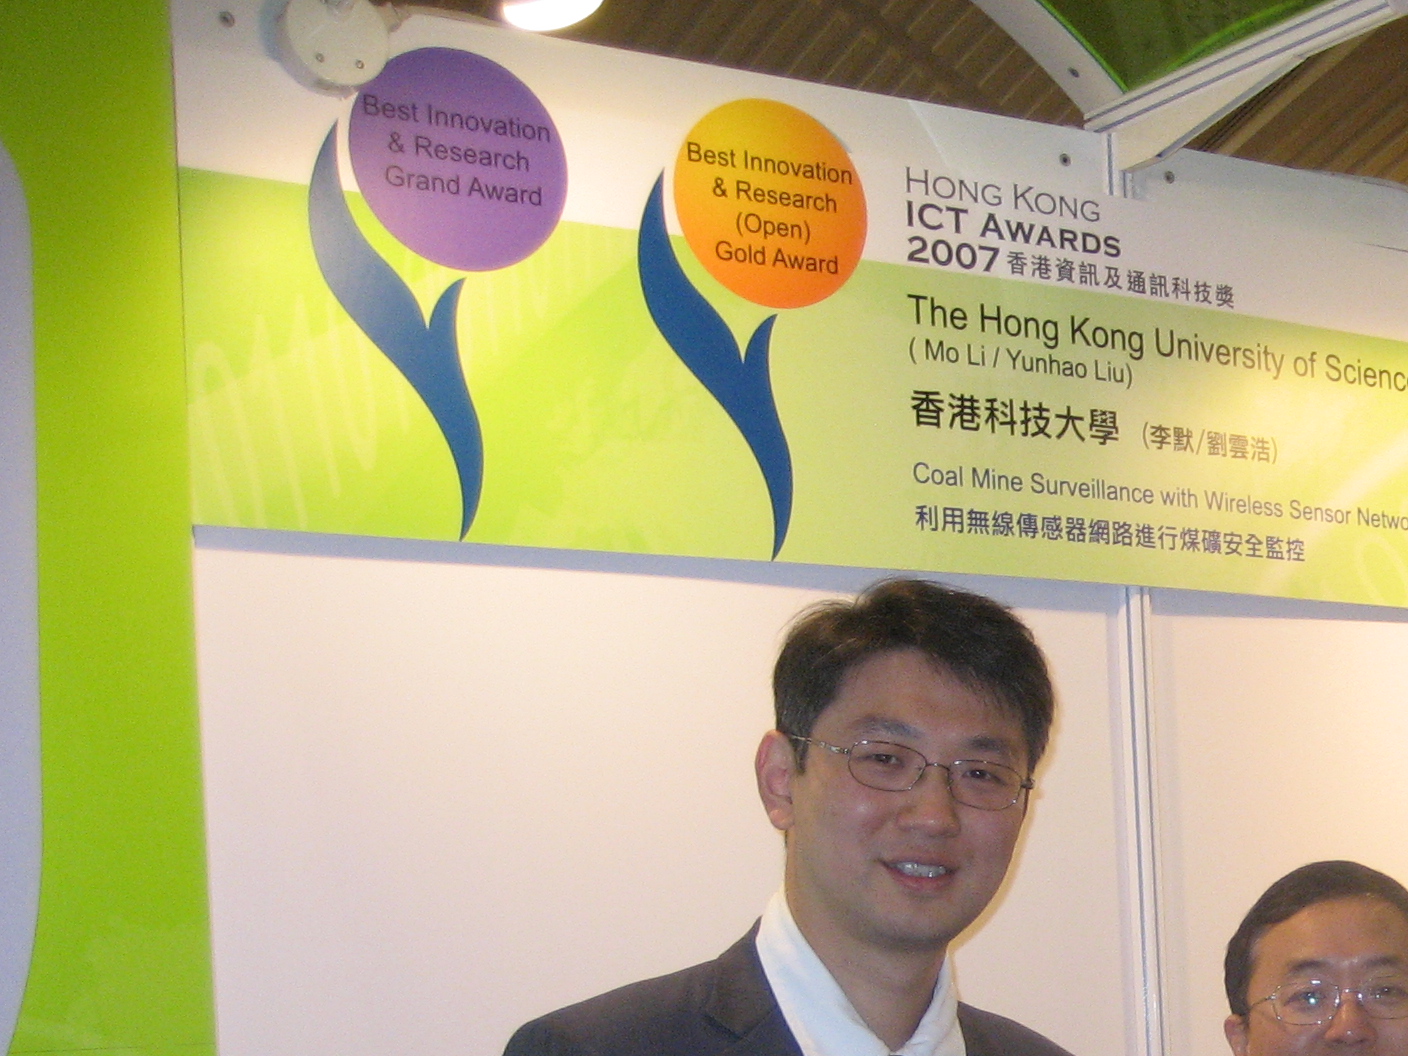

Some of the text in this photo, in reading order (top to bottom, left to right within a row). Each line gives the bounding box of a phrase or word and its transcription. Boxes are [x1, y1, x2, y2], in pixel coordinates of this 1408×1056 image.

[362, 94, 551, 143] Best Innovation
[388, 131, 530, 172] & Research
[687, 143, 853, 185] Best Innovation
[384, 164, 542, 206] Grand Award
[712, 178, 837, 213] & Research
[905, 167, 1100, 222] HONG KONG
[736, 213, 811, 244] (Open)
[906, 200, 1122, 257] ICT AWARDS
[715, 241, 839, 275] Gold Award
[907, 236, 1000, 272] 2007
[907, 294, 968, 330] The
[980, 303, 1058, 349] Hong
[1070, 316, 1144, 360] Kong
[1155, 328, 1285, 380] University
[1293, 351, 1317, 379] of
[968, 344, 986, 367] Li
[1006, 350, 1088, 379] Yunhao
[1094, 360, 1133, 390] Liu)
[911, 389, 1120, 446] 香港科技大學
[912, 462, 965, 487] Coal
[972, 466, 1023, 493] Mine
[1030, 473, 1154, 504] Surveillance
[1161, 486, 1198, 509] with
[1203, 490, 1284, 518] Wireless
[1289, 499, 1351, 525] Sensor
